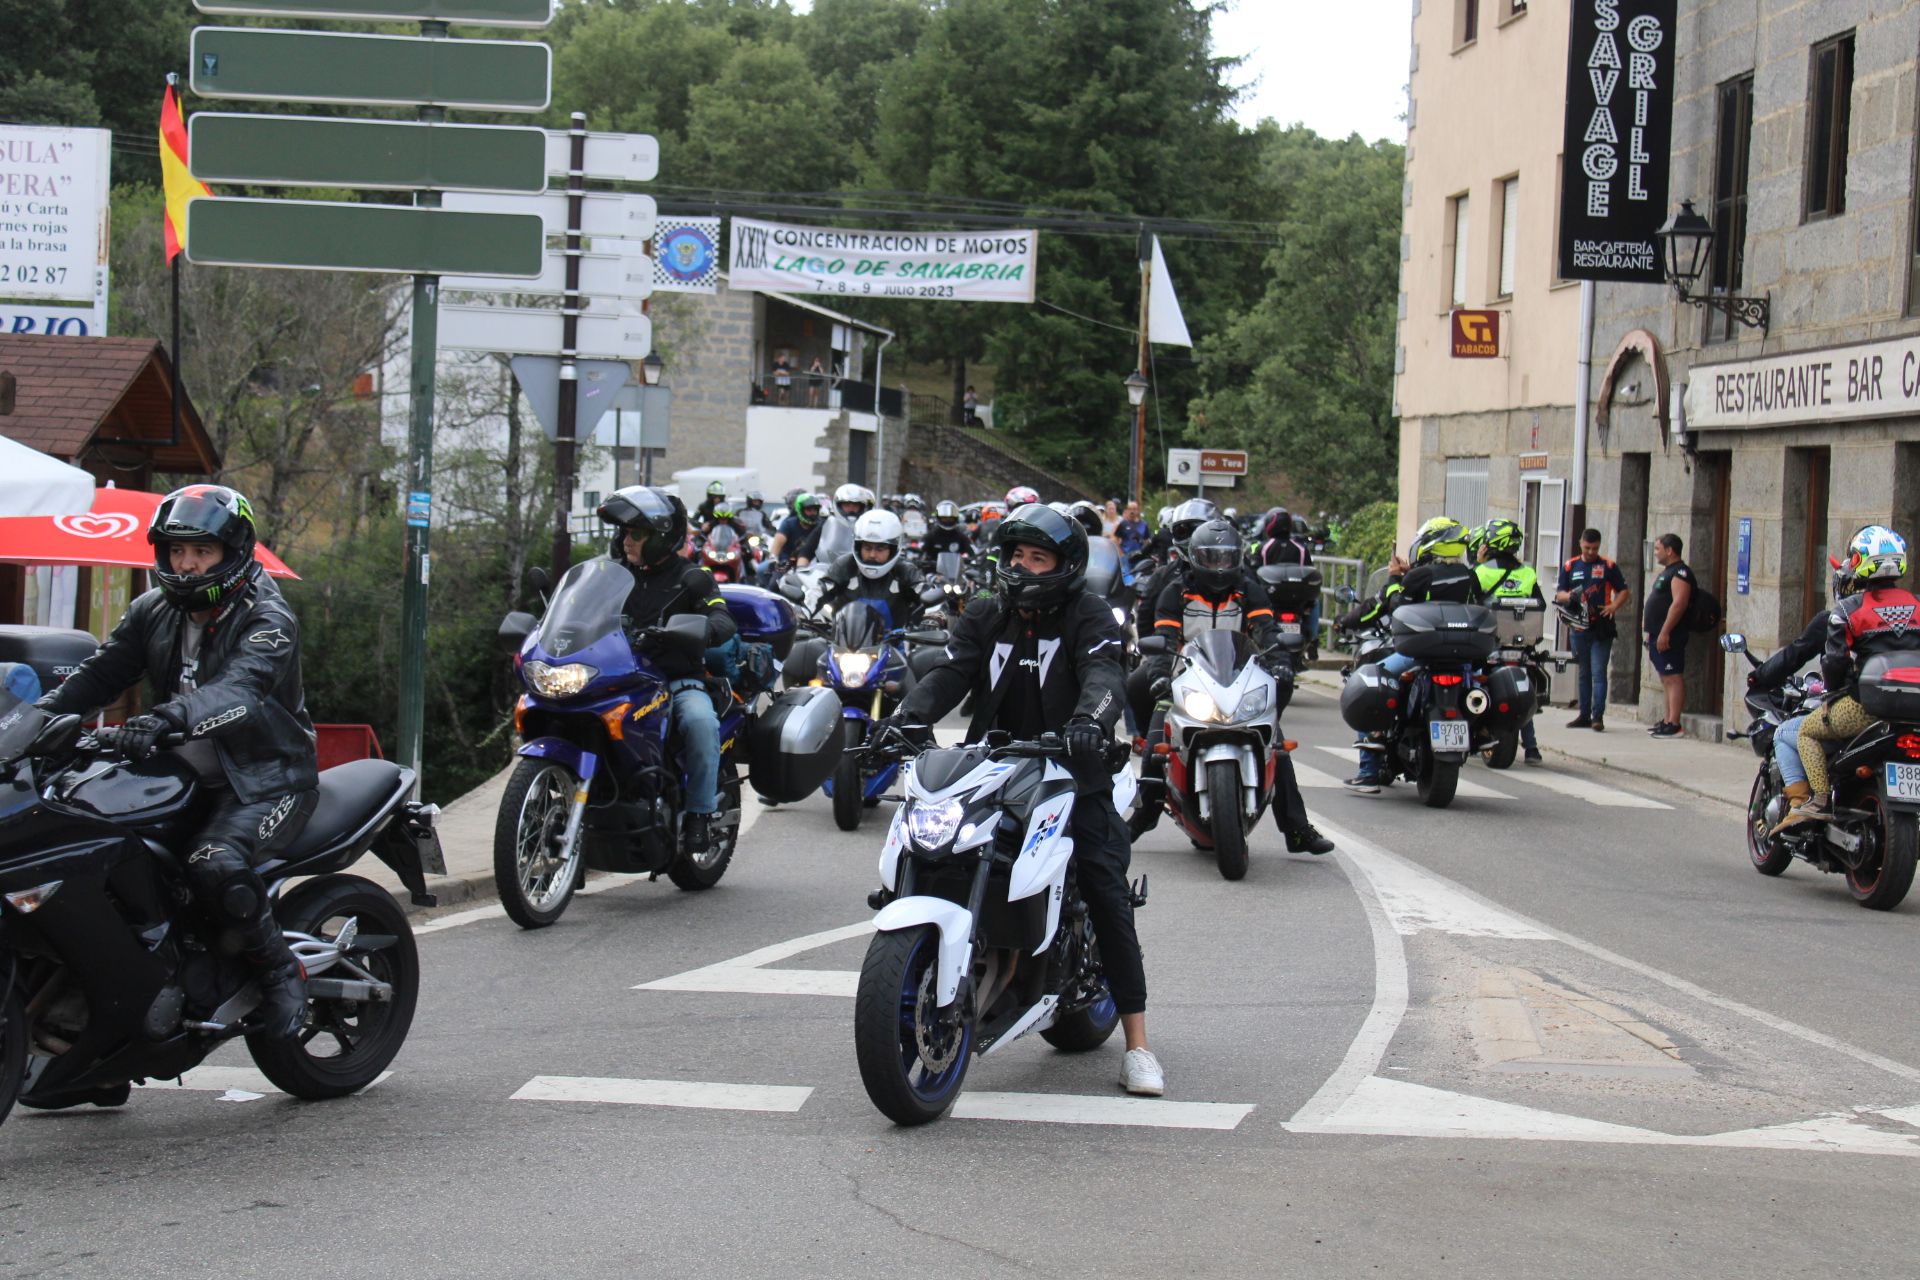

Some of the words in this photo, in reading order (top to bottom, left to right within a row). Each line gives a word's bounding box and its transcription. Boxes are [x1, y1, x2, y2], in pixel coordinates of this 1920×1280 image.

[1582, 0, 1622, 217] SAVAGE
[1627, 15, 1663, 200] GRILL
[14, 204, 22, 217] y
[27, 201, 68, 215] Carta
[33, 221, 68, 236] rojas
[11, 238, 22, 250] la
[28, 239, 67, 252] brasa
[735, 226, 769, 269] XXIX
[774, 229, 928, 252] CONCENTRACION
[936, 238, 957, 253] DE
[963, 237, 1028, 254] MOTOS
[1574, 240, 1654, 256] BAR-CAFETERÍA
[773, 255, 846, 274] LAGO
[854, 259, 890, 276] DE
[896, 261, 1025, 281] SANABRIA
[1573, 253, 1654, 270] RESTAURANTE
[0, 264, 10, 282] 2
[17, 265, 38, 283] 02
[45, 266, 68, 285] 87
[816, 279, 824, 291] 7
[838, 281, 846, 293] 8
[863, 282, 871, 294] 9
[884, 285, 915, 296] JULIO
[919, 285, 954, 298] 2023
[1455, 344, 1496, 355] TABACOS
[1716, 362, 1832, 414] RESTAURANTE
[1848, 355, 1883, 403] BAR
[1440, 724, 1467, 735] 9780
